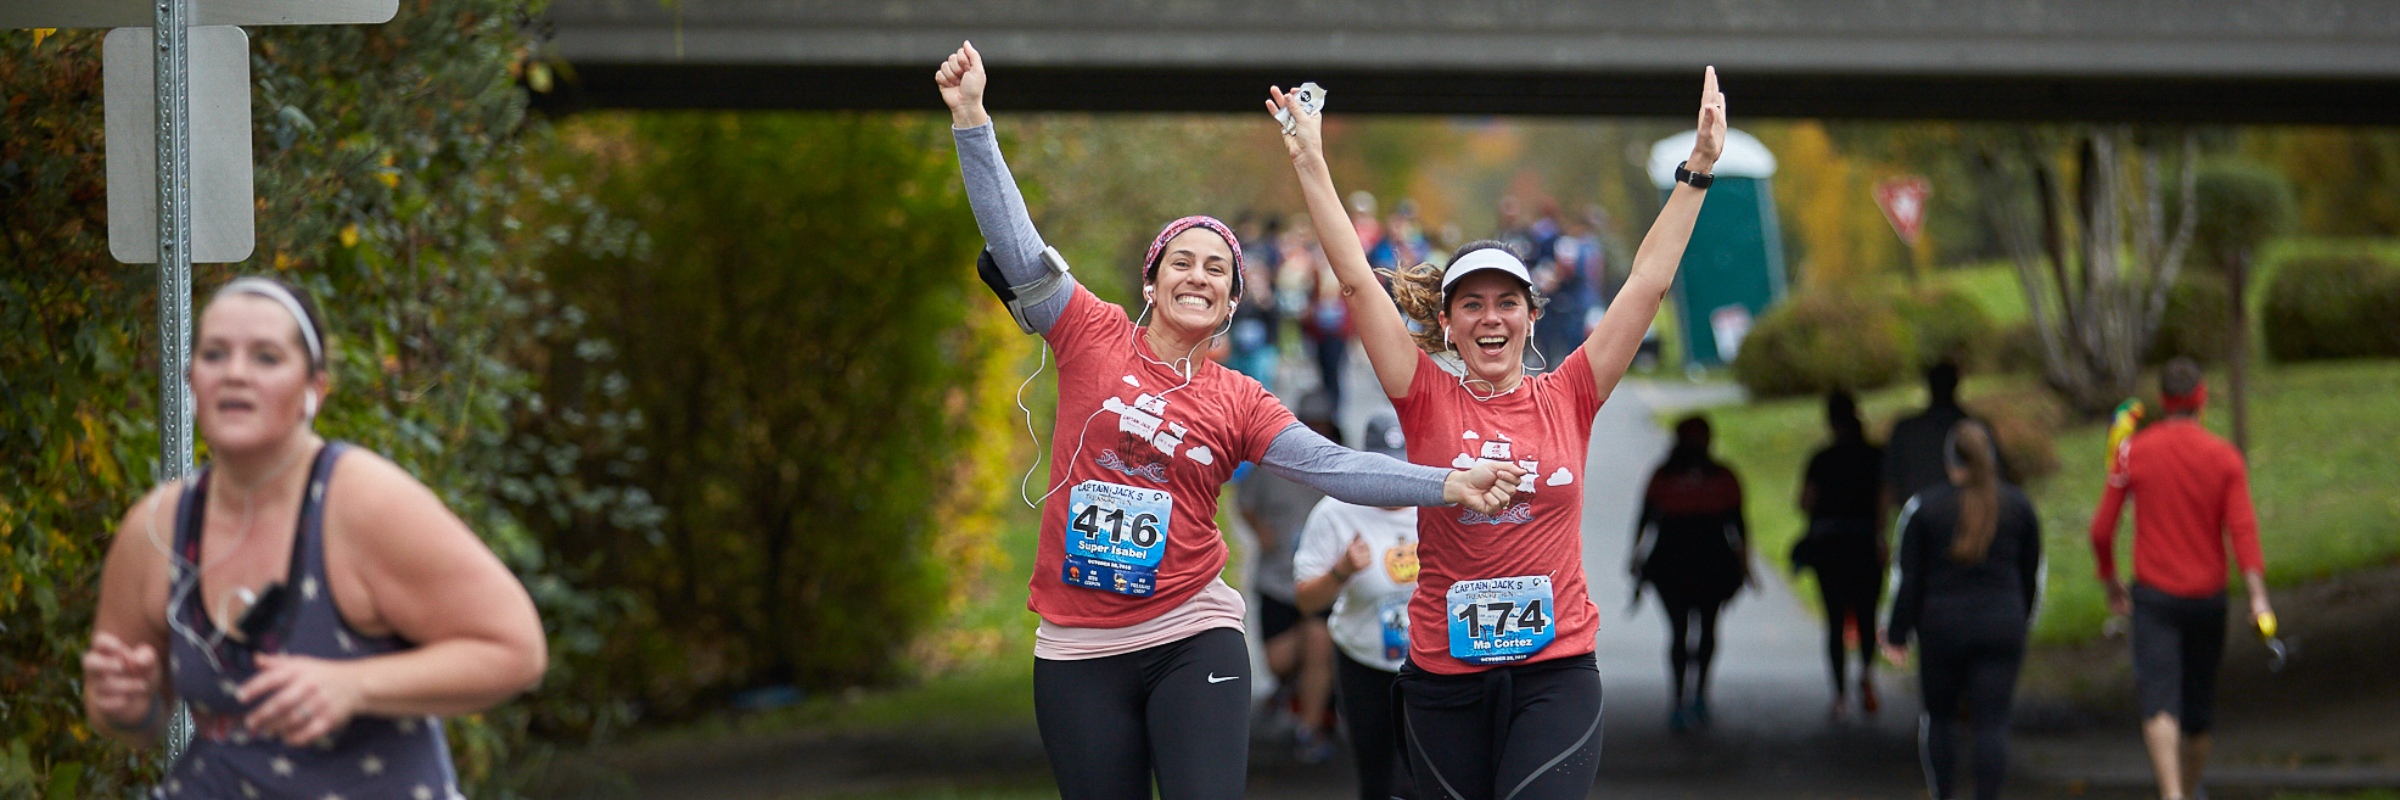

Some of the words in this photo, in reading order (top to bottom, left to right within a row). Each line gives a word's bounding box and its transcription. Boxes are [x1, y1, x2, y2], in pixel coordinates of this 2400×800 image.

[1078, 483, 1109, 494] CAPTAIN
[1072, 504, 1159, 548] 416
[1078, 541, 1109, 554] Super
[1111, 545, 1147, 560] Isabel
[1458, 599, 1546, 638] 174
[1473, 640, 1491, 650] Ma
[1494, 638, 1533, 648] Cortez
